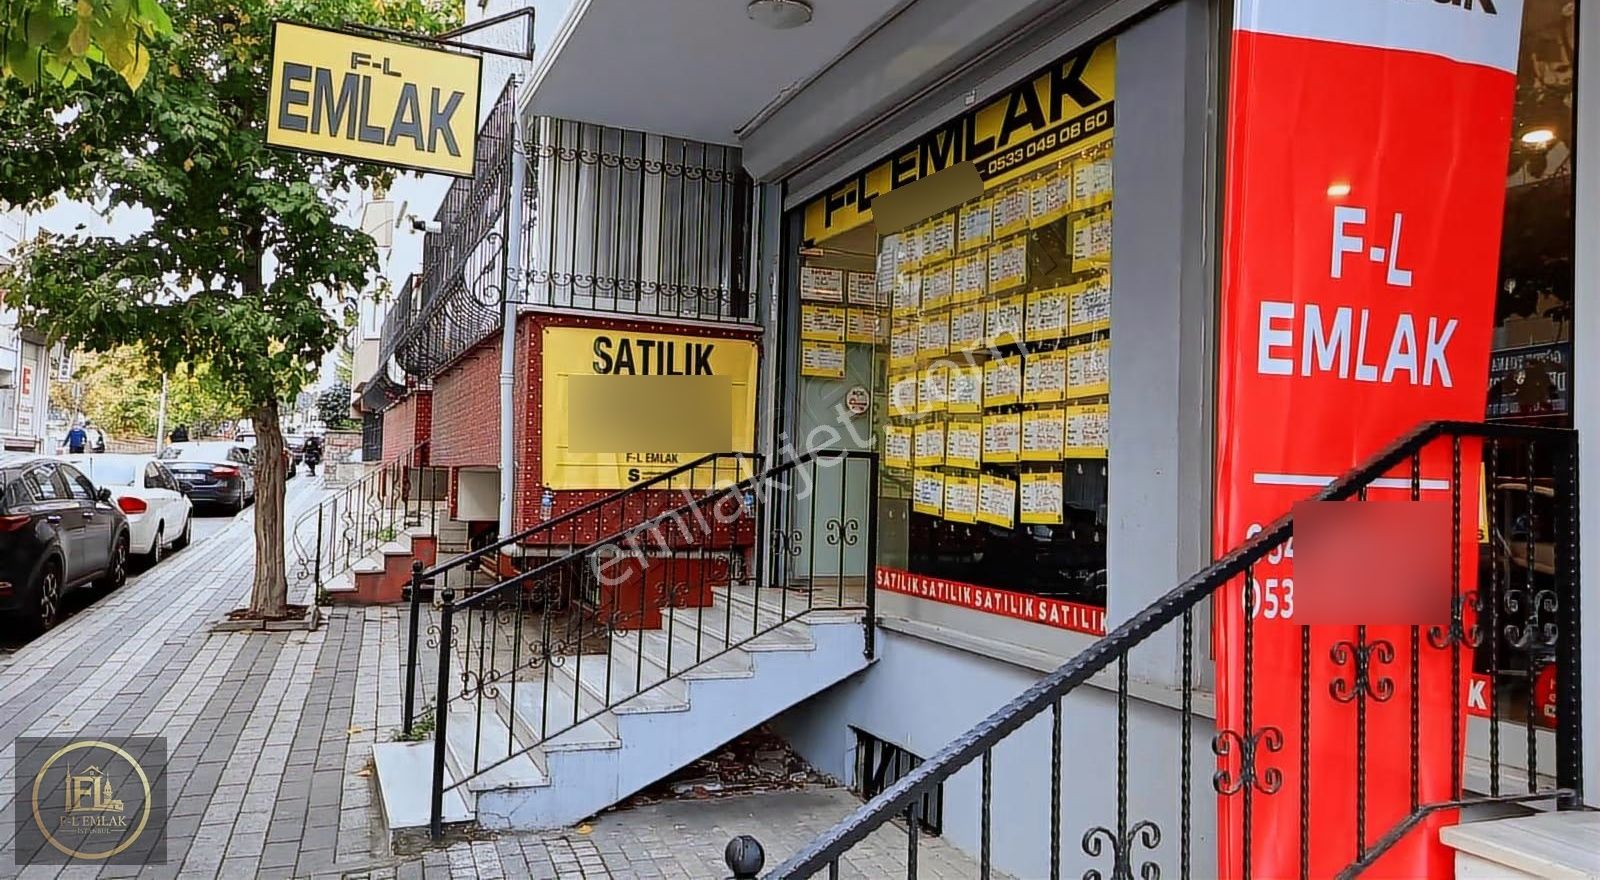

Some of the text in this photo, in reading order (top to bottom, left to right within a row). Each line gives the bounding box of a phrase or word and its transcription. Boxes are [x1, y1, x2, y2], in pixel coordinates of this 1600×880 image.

[351, 52, 402, 77] F-L
[279, 62, 465, 157] EMLAK
[890, 44, 1102, 191] EMLAK
[988, 110, 1107, 174] 0533 049 08 60
[1330, 206, 1413, 287] F-L
[592, 336, 715, 376] SATILIK
[1257, 300, 1458, 388] EMLAK
[626, 452, 678, 464] F-L EMLAK
[876, 569, 919, 594] SATILIK
[921, 579, 971, 604] SATILIK
[974, 589, 1034, 618] SATILIK
